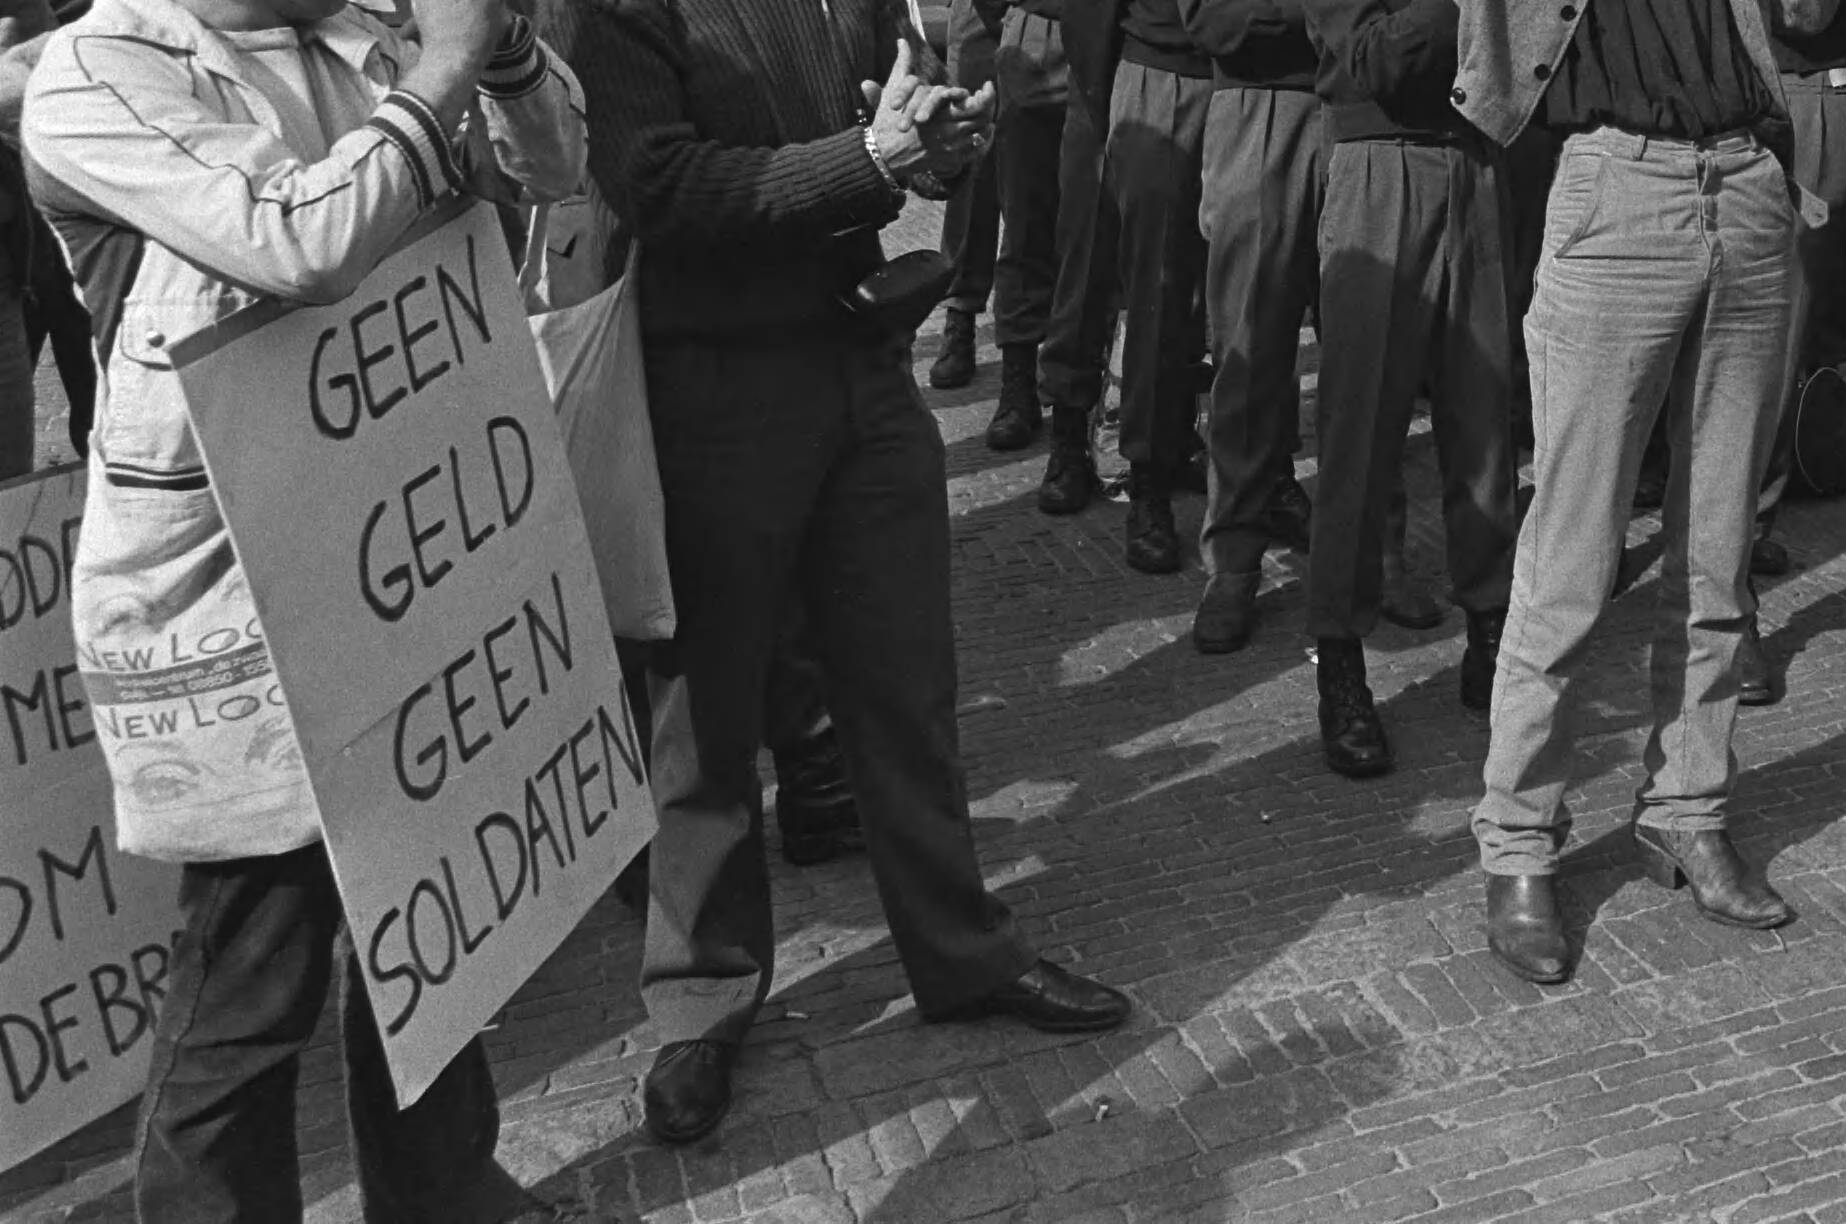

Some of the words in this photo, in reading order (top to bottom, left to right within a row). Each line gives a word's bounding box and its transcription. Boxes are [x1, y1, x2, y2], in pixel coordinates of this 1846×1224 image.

[309, 234, 492, 440] GEEN
[358, 415, 534, 622] GELD
[393, 572, 573, 802] GEEN
[368, 677, 645, 1038] SOLDATEN
